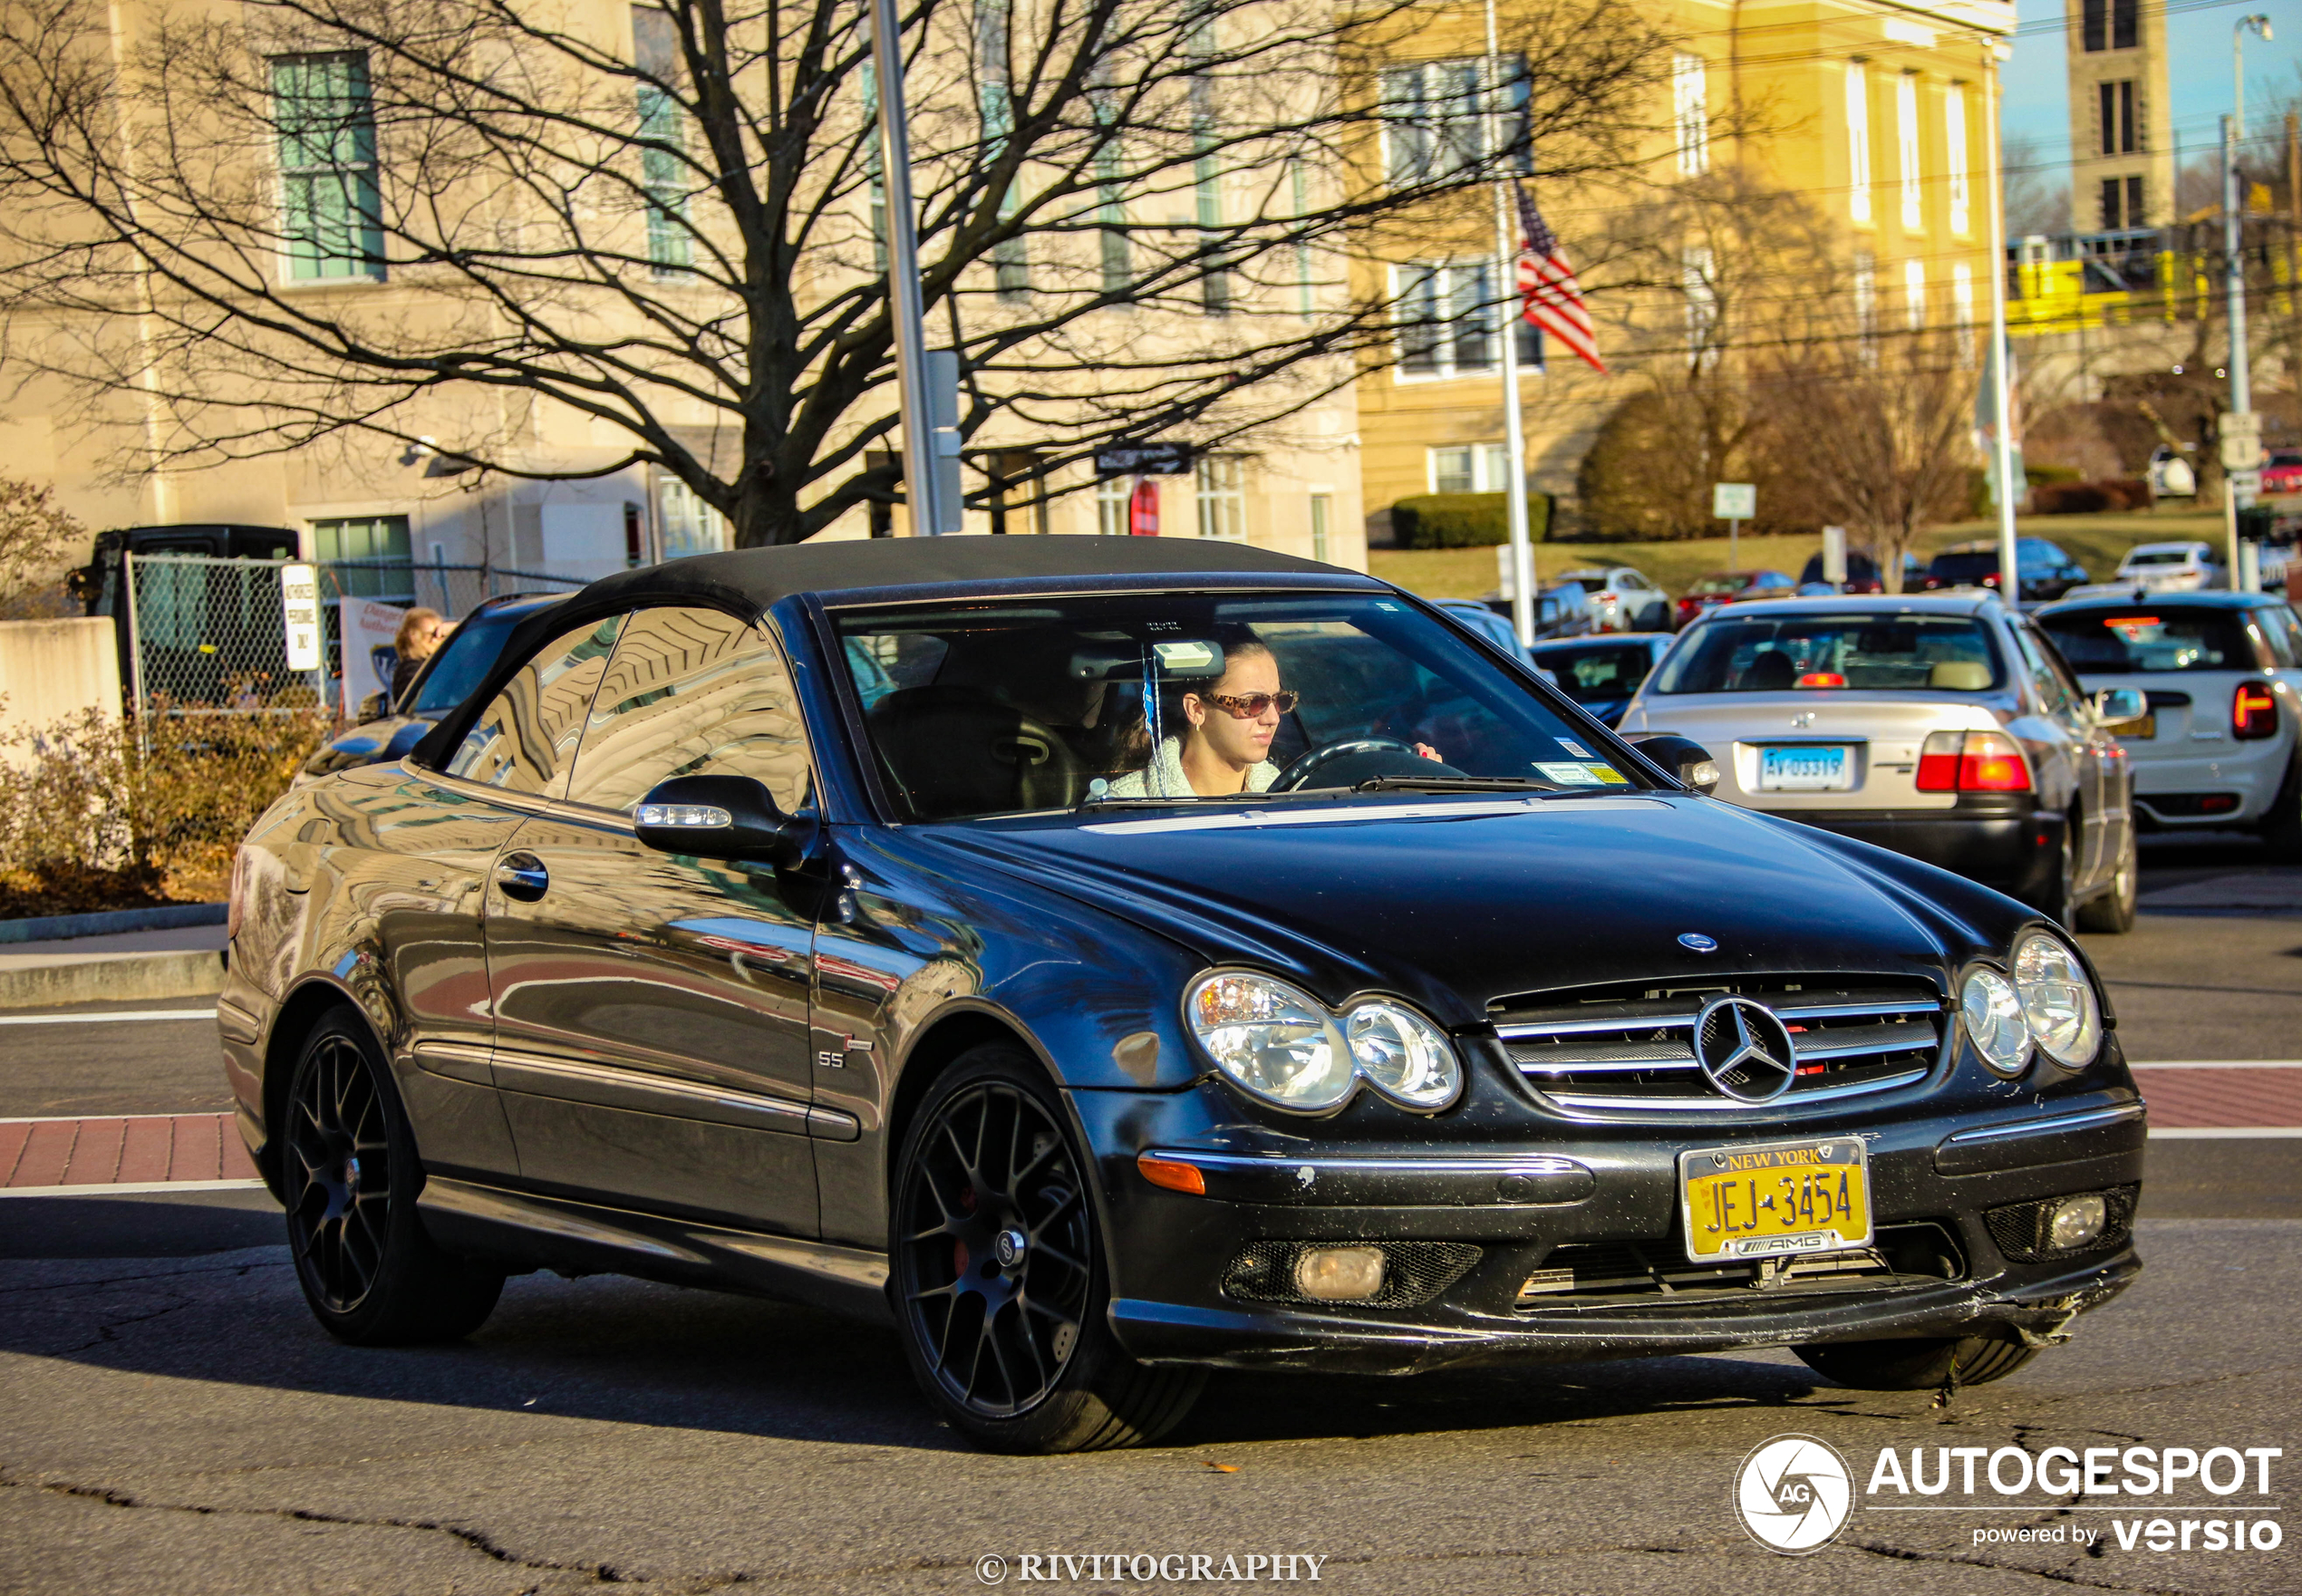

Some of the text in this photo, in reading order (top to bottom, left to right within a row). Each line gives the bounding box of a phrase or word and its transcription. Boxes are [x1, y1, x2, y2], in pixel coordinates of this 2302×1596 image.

[818, 1051, 844, 1068] 55
[1728, 1148, 1823, 1171] NEW YORK
